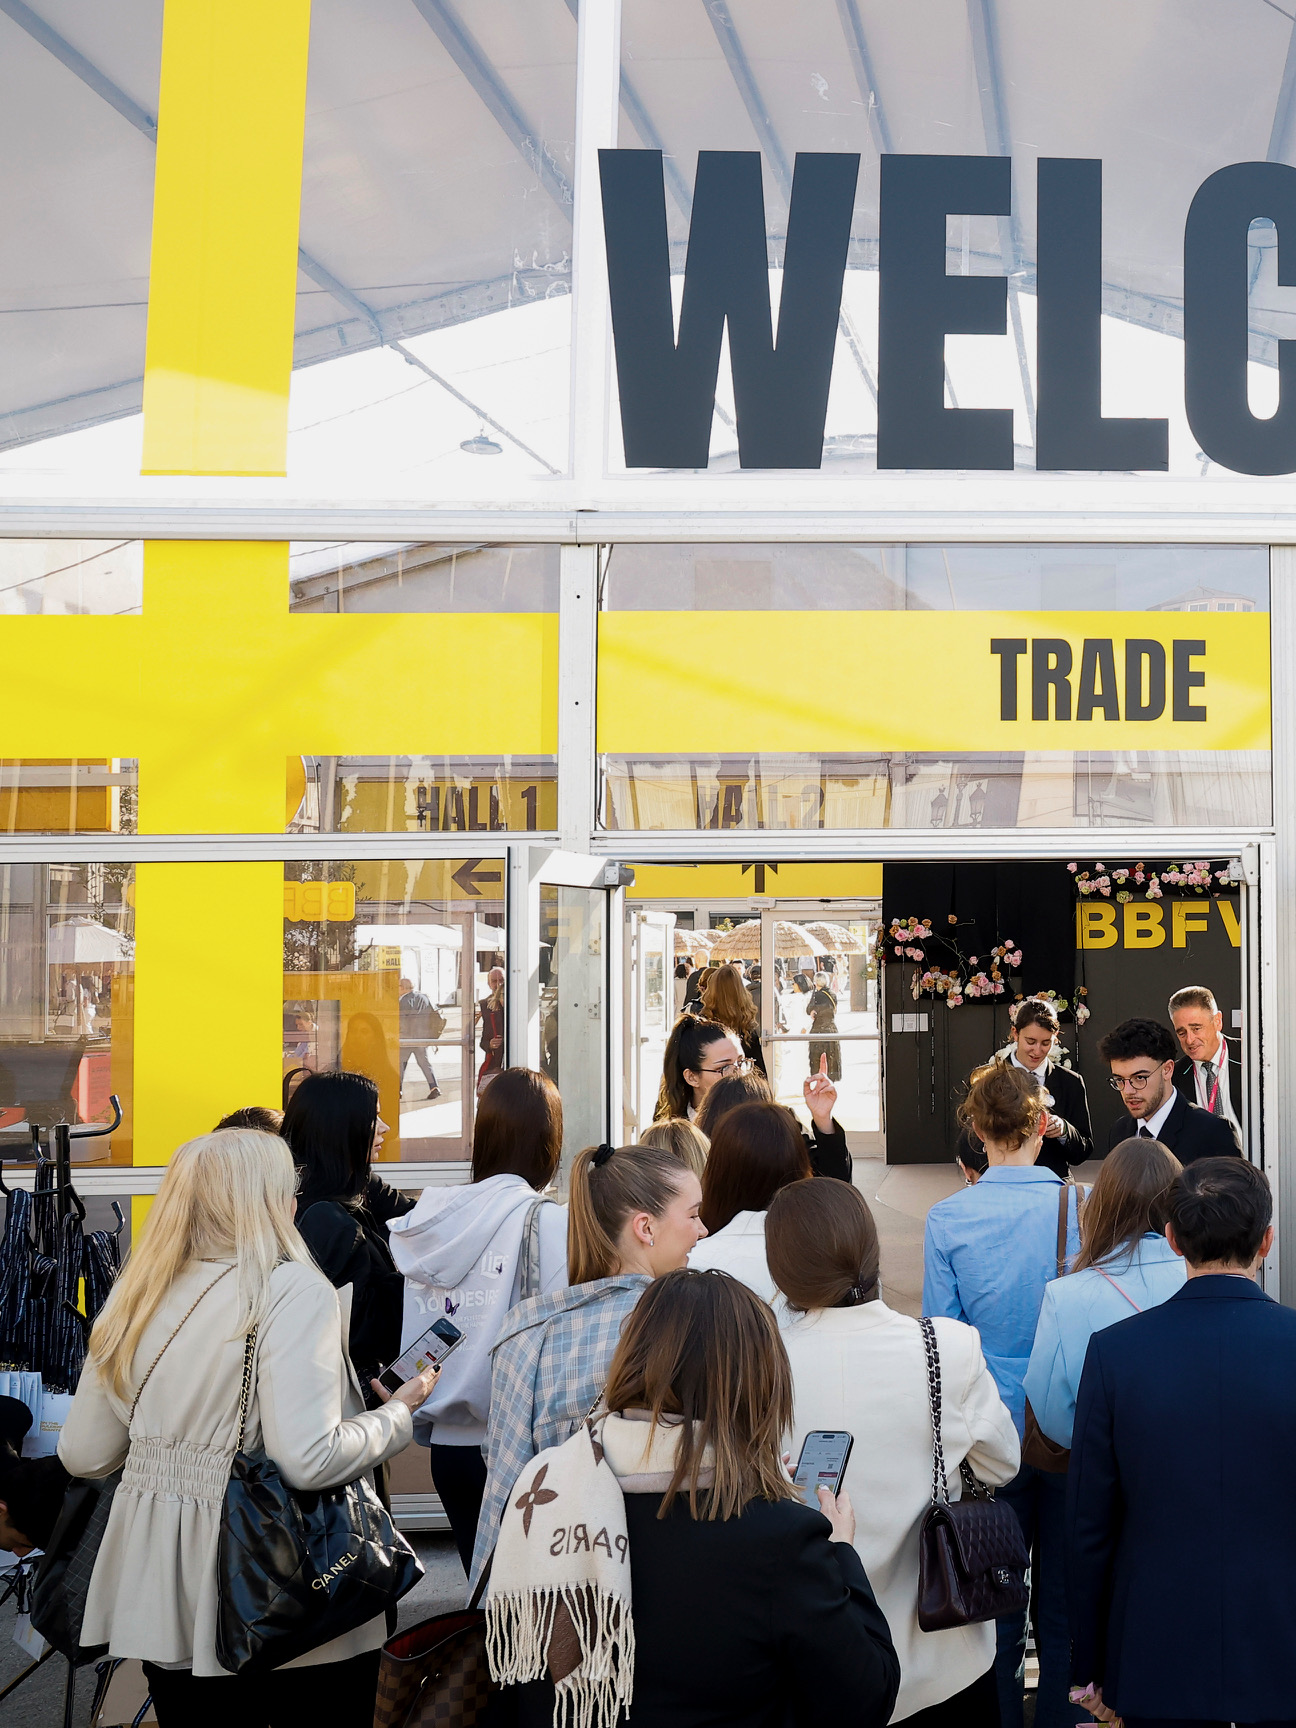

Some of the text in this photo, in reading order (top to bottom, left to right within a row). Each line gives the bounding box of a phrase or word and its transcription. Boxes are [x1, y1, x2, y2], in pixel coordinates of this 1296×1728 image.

[990, 637, 1208, 722] TRADE
[417, 785, 537, 831] HALL 1
